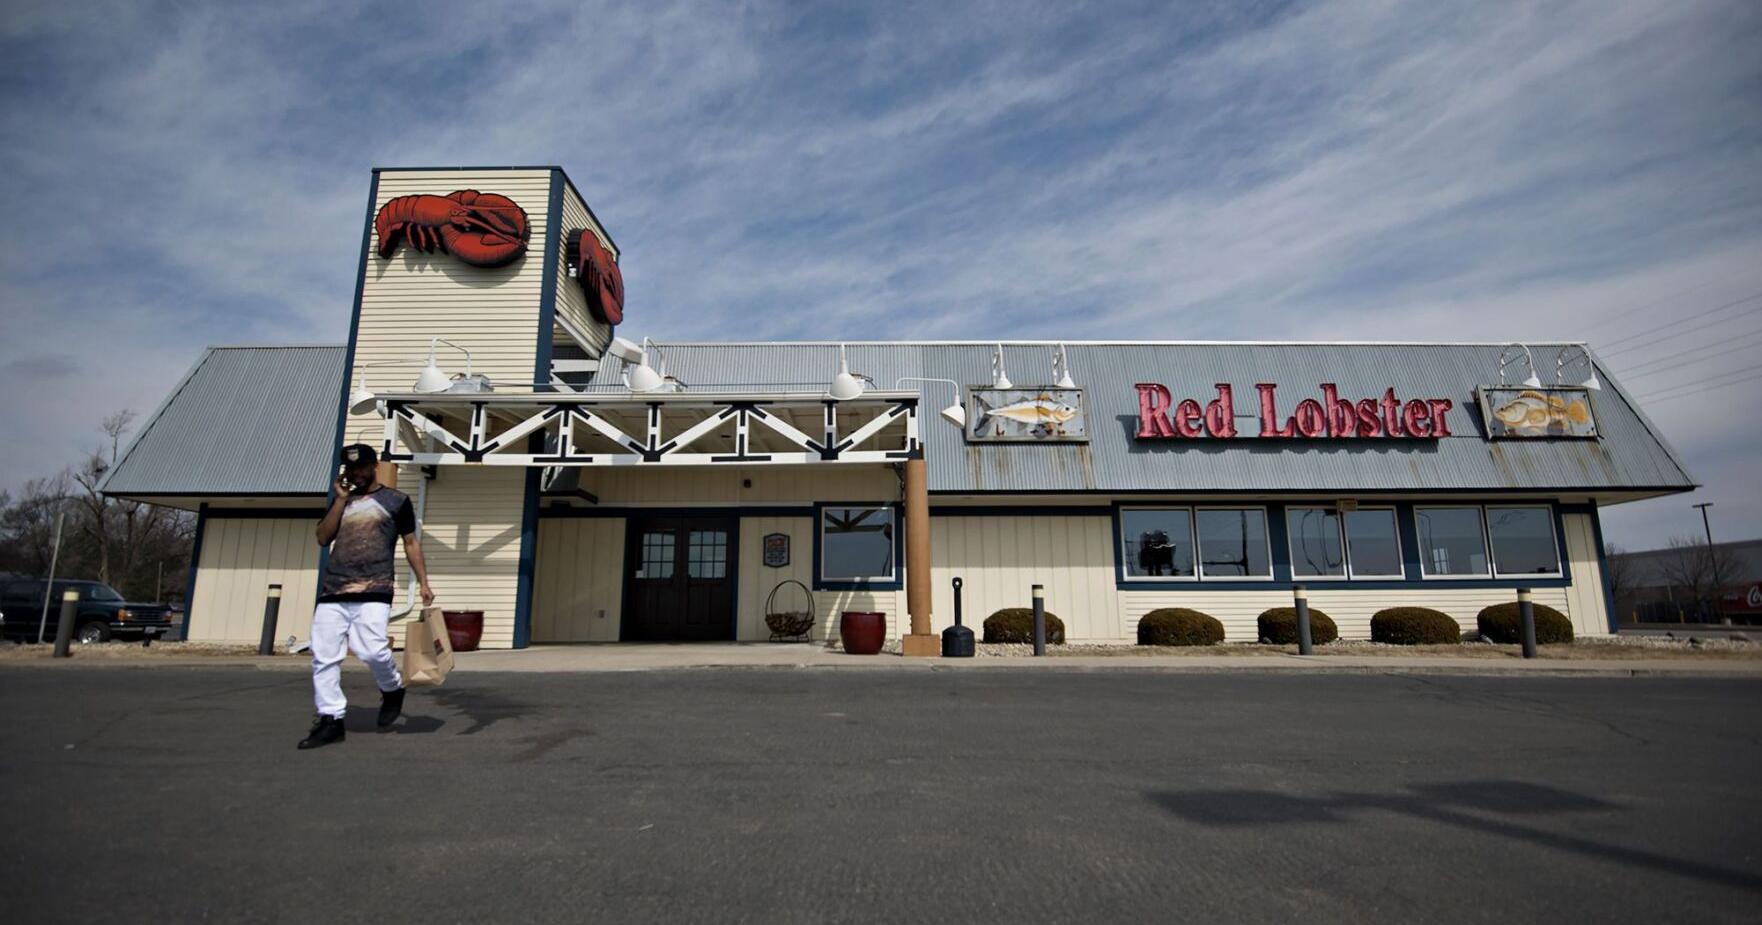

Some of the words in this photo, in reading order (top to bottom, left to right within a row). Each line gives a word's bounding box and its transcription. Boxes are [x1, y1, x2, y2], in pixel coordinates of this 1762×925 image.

[1134, 383, 1237, 438] Red
[1255, 383, 1453, 438] Lobster
[1747, 585, 1762, 607] Co
